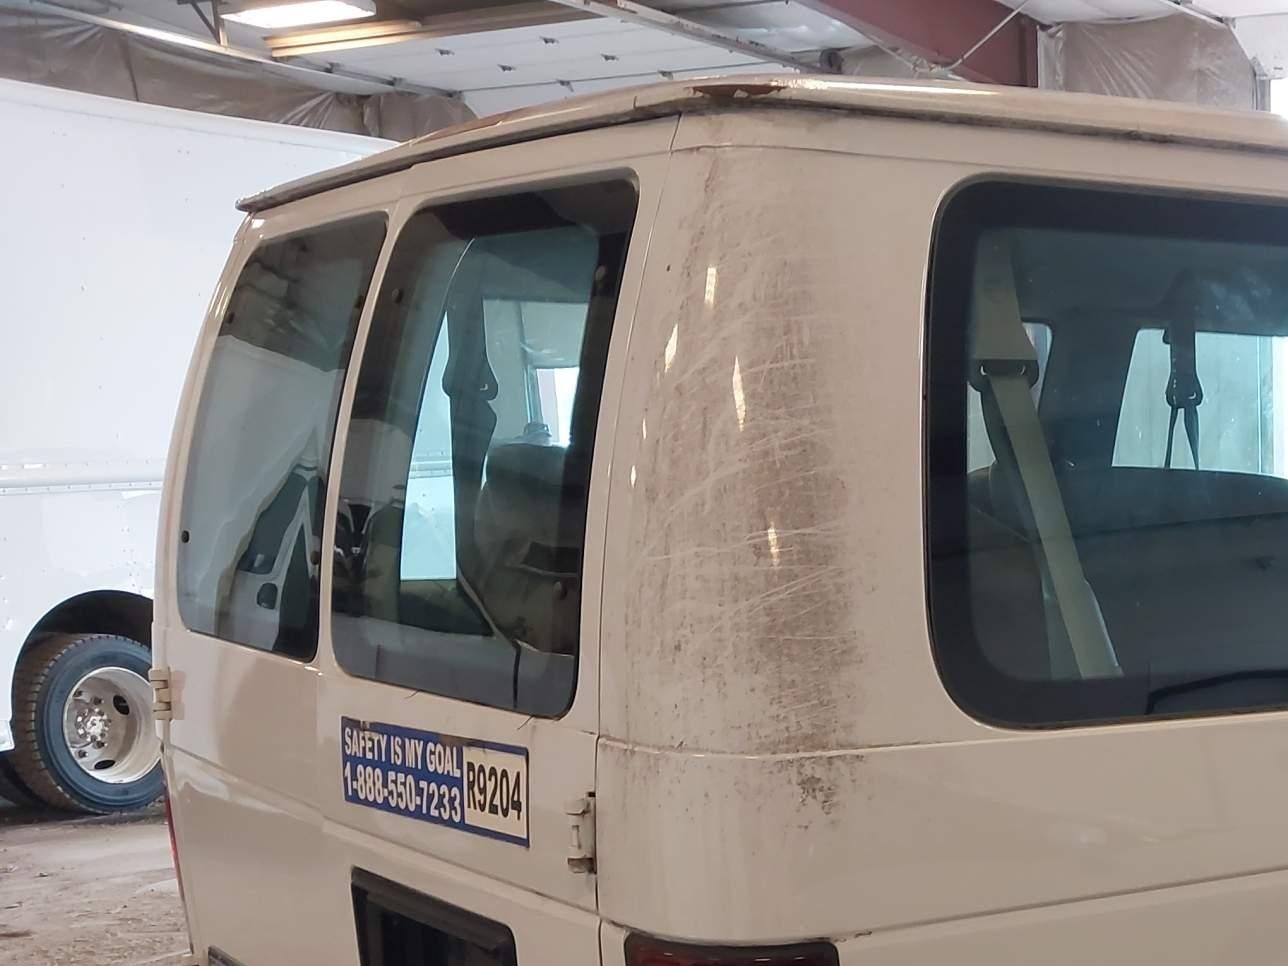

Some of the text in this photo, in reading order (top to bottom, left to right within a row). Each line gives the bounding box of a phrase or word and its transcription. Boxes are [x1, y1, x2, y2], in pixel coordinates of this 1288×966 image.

[344, 727, 461, 778] SAFETY IS MY GOAL
[344, 761, 462, 823] 1-888-550-7233
[466, 761, 522, 821] R9204
